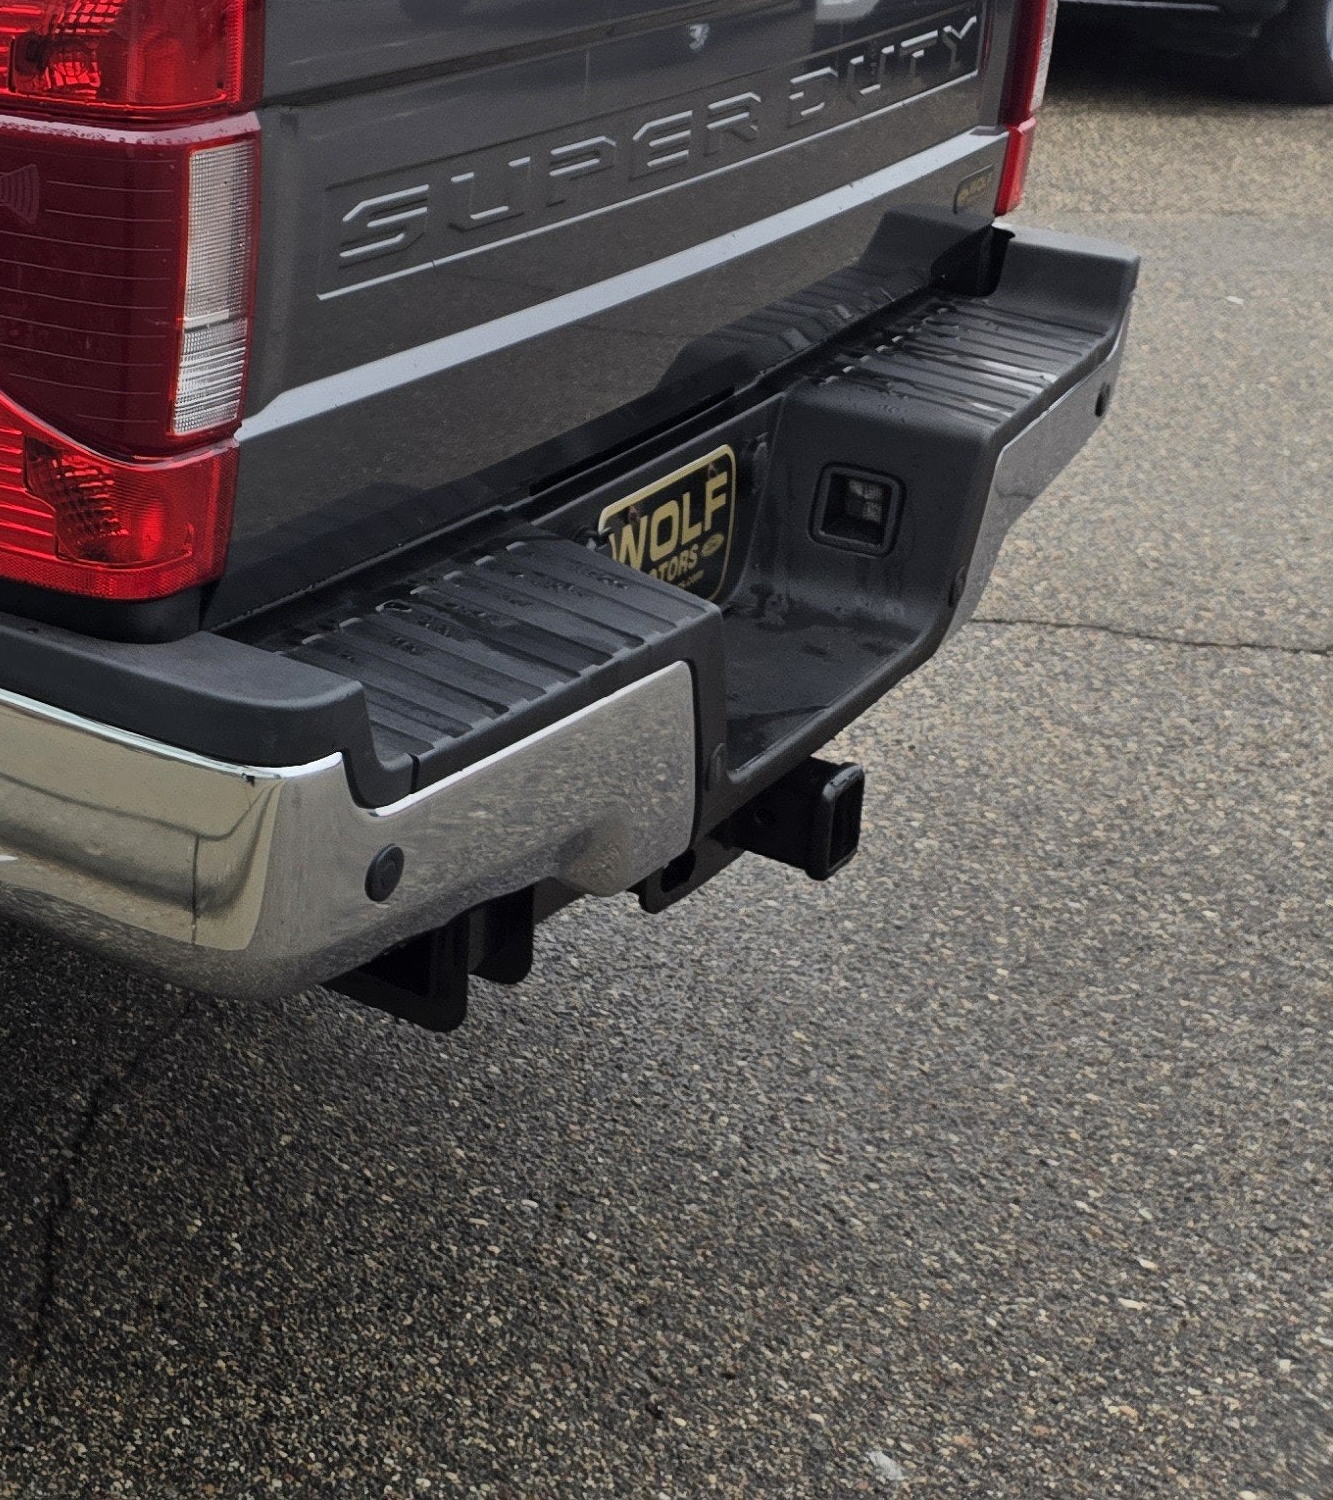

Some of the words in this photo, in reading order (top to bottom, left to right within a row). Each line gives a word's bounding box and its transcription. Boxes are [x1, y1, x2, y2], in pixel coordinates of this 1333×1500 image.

[337, 91, 761, 270] SUPER
[786, 15, 979, 129] DUTY
[607, 470, 729, 573] WOLF
[648, 543, 699, 583] TORS
